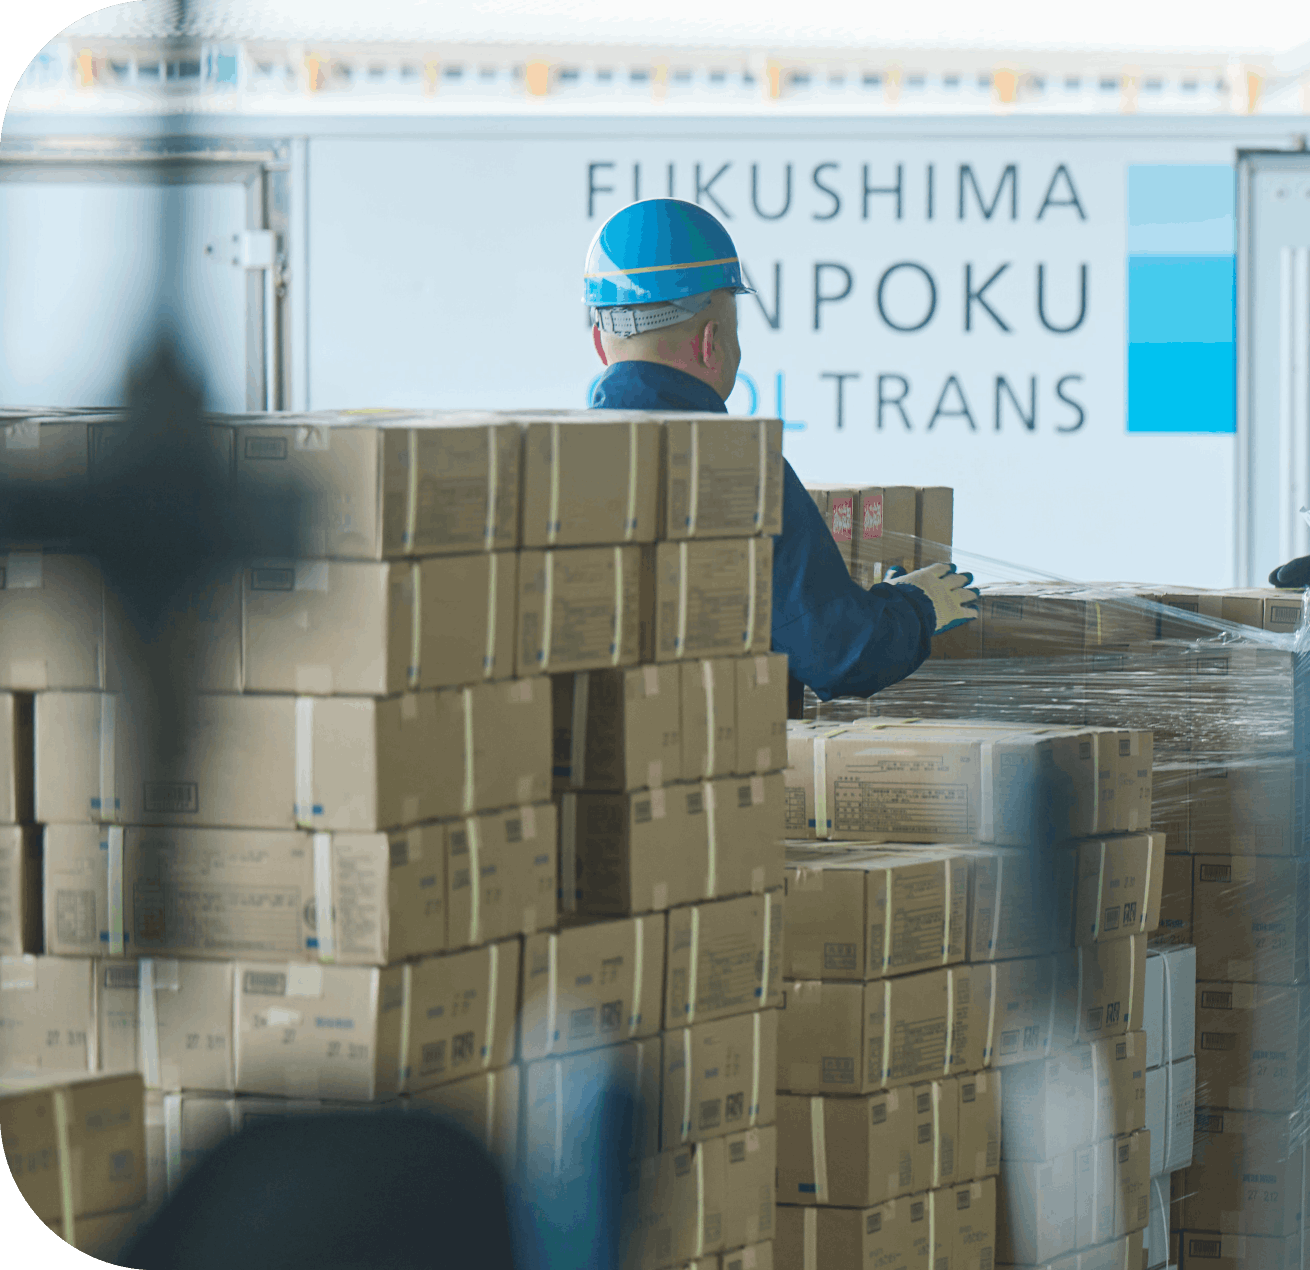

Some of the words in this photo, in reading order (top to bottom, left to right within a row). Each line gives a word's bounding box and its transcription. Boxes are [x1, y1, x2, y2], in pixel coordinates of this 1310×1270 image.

[586, 161, 1088, 221] FUKUSHIMA
[586, 261, 1090, 335] NPOKU
[1247, 1189, 1259, 1201] 27
